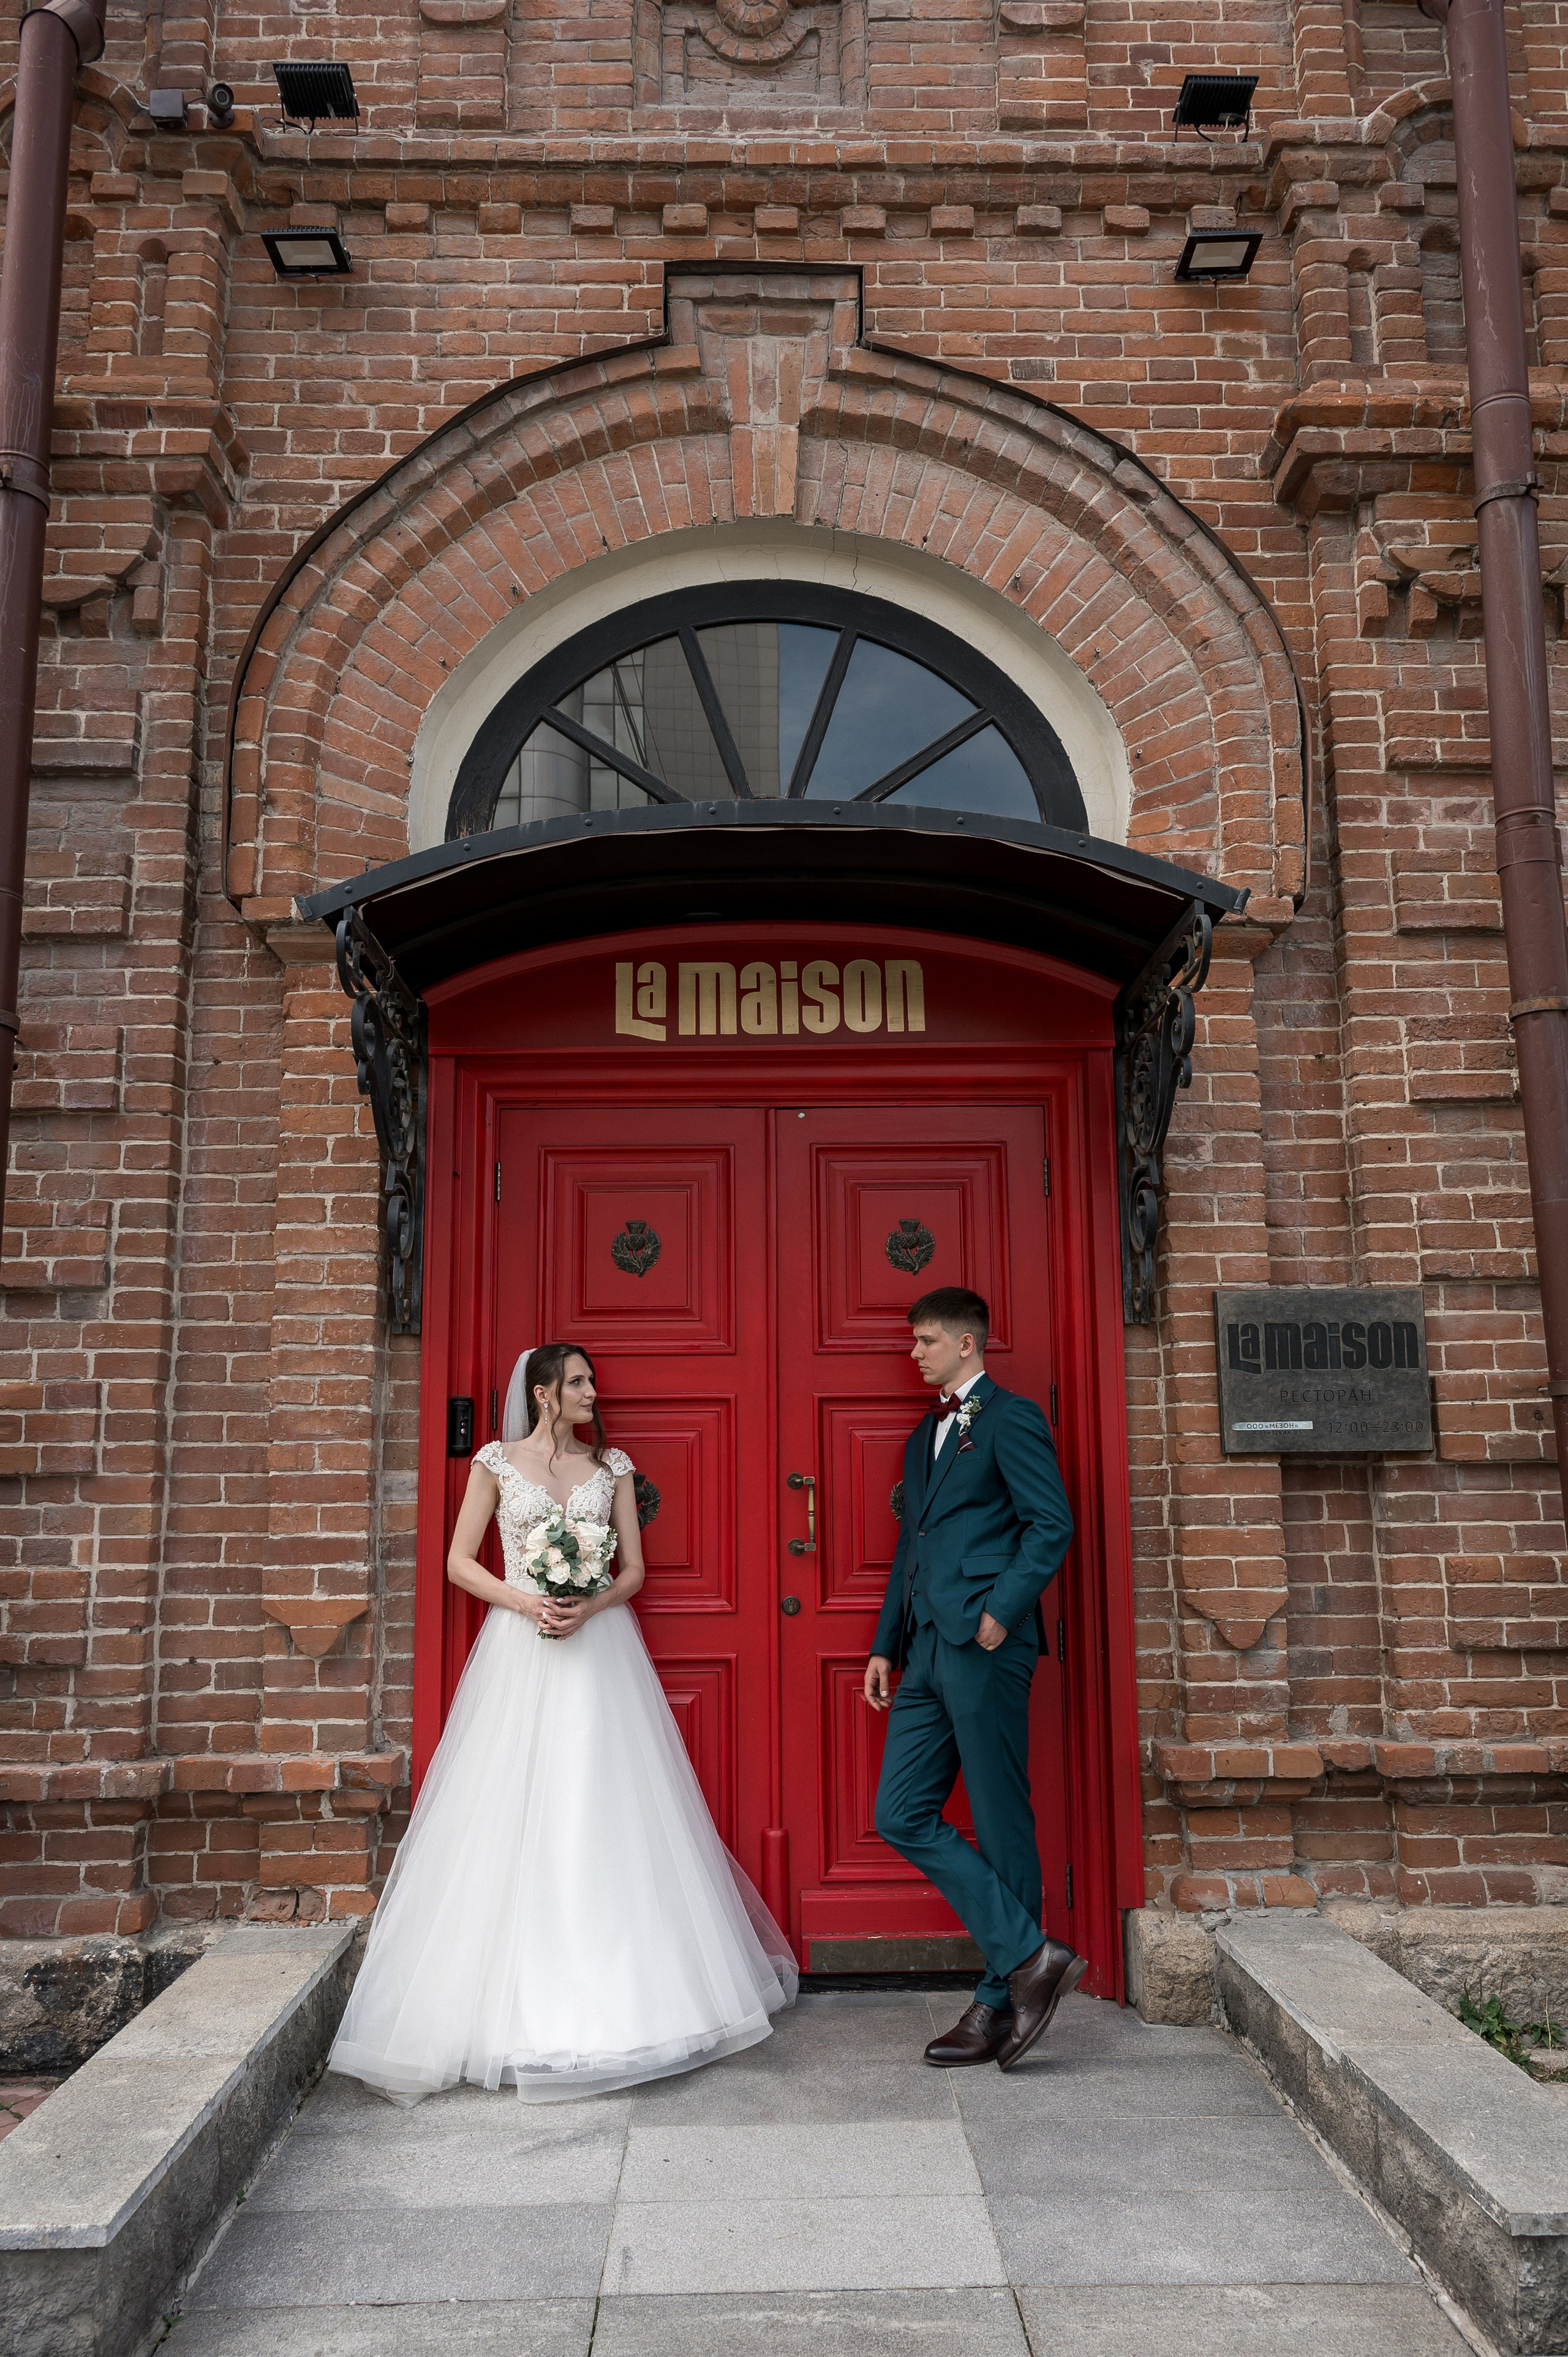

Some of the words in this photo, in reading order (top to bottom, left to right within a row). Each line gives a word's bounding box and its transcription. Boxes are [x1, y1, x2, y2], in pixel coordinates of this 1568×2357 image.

[616, 962, 666, 1041] La
[678, 959, 925, 1035] maison
[1227, 1323, 1262, 1375] La
[1264, 1322, 1420, 1370] maison
[1280, 1389, 1371, 1403] РЕСТОРАН
